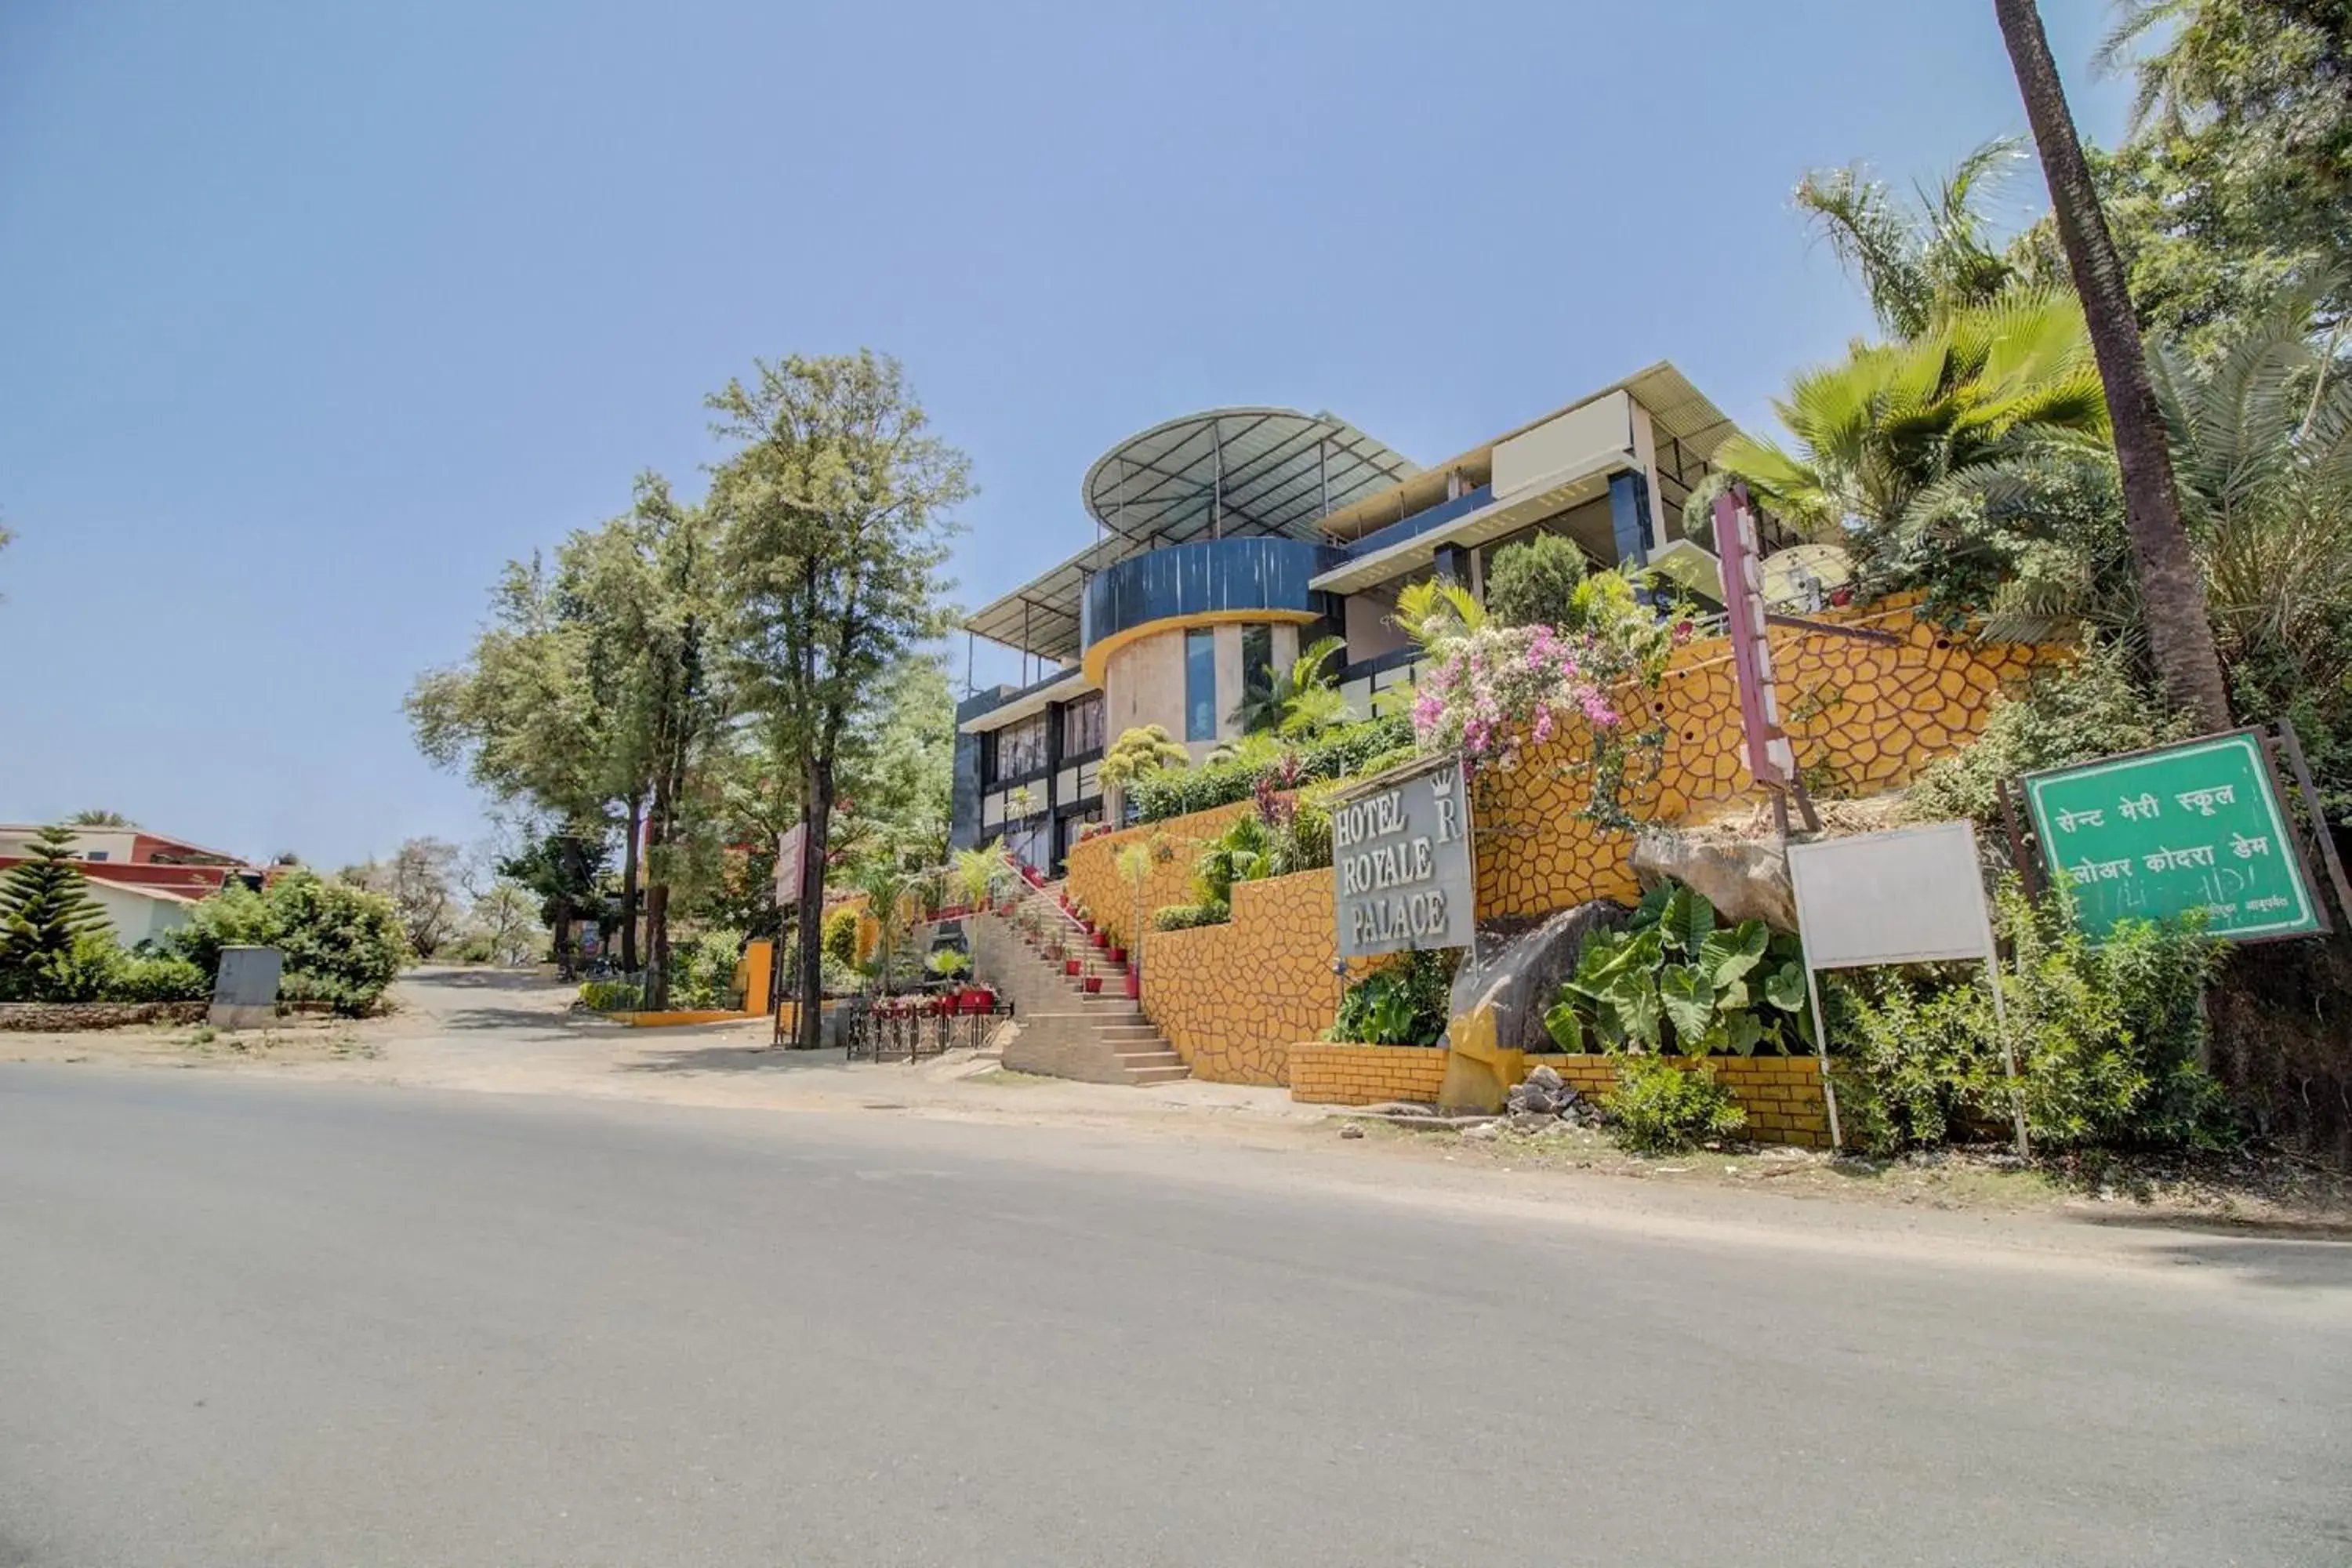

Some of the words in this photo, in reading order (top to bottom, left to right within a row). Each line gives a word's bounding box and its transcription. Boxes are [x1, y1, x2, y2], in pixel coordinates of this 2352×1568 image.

[1337, 790, 1406, 847] HOTEL
[1435, 797, 1462, 844] R
[2055, 807, 2104, 833] सेन्ट
[2118, 793, 2160, 822] मेरी
[2175, 784, 2236, 816] स्कूल
[1342, 836, 1432, 895] ROYALE
[2069, 857, 2133, 884] लोअर
[2143, 845, 2215, 873] कोदरा
[2229, 832, 2269, 858] डेम
[1352, 890, 1446, 944] PALACE
